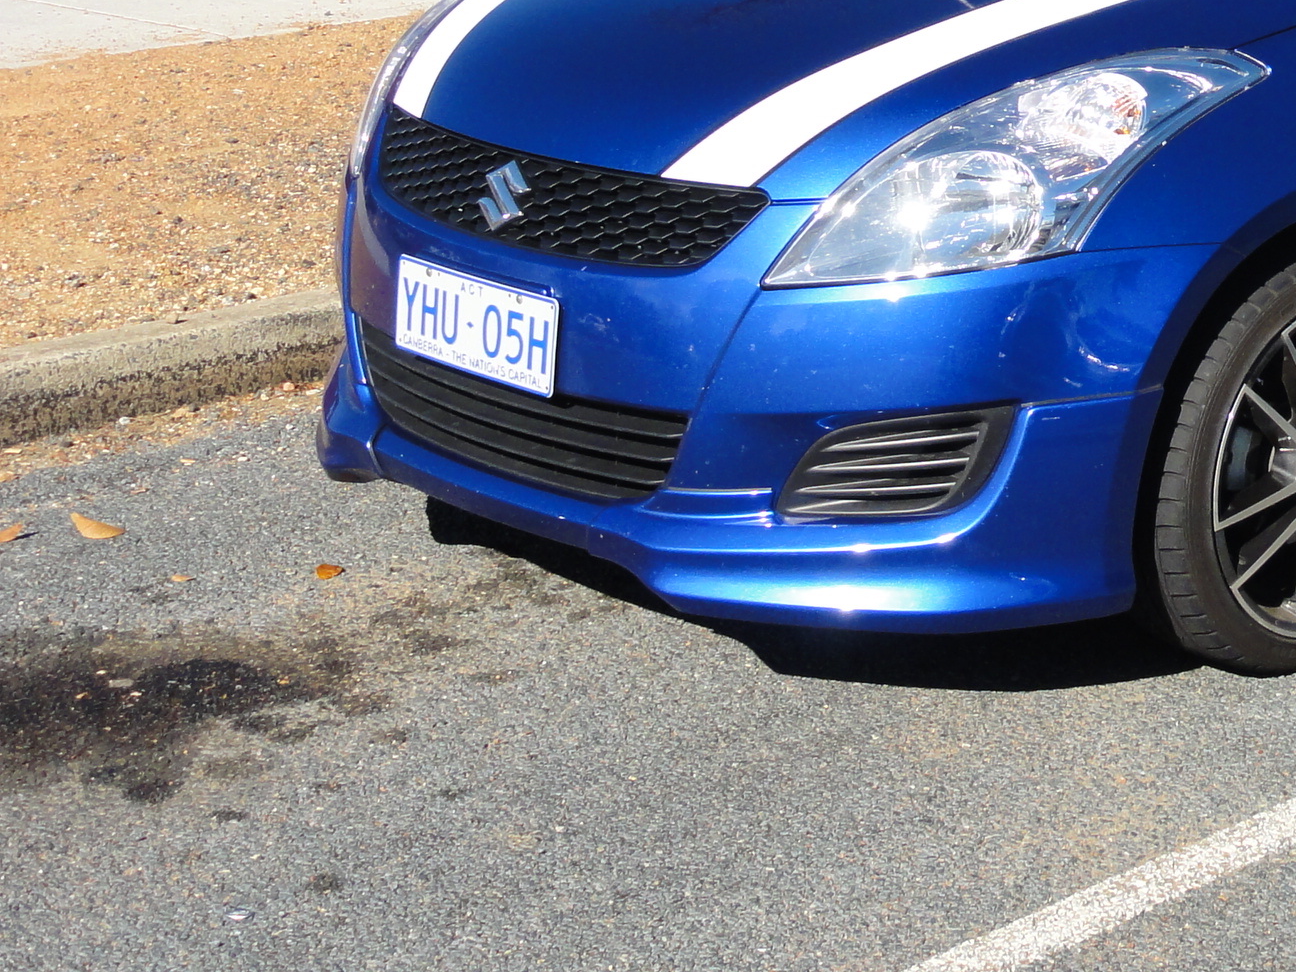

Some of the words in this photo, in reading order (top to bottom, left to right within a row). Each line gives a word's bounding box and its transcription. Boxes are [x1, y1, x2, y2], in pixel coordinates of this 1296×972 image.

[460, 281, 484, 298] ACT
[403, 333, 443, 356] CANBERRA
[452, 350, 467, 365] THE
[508, 368, 543, 389] CAPITAL
